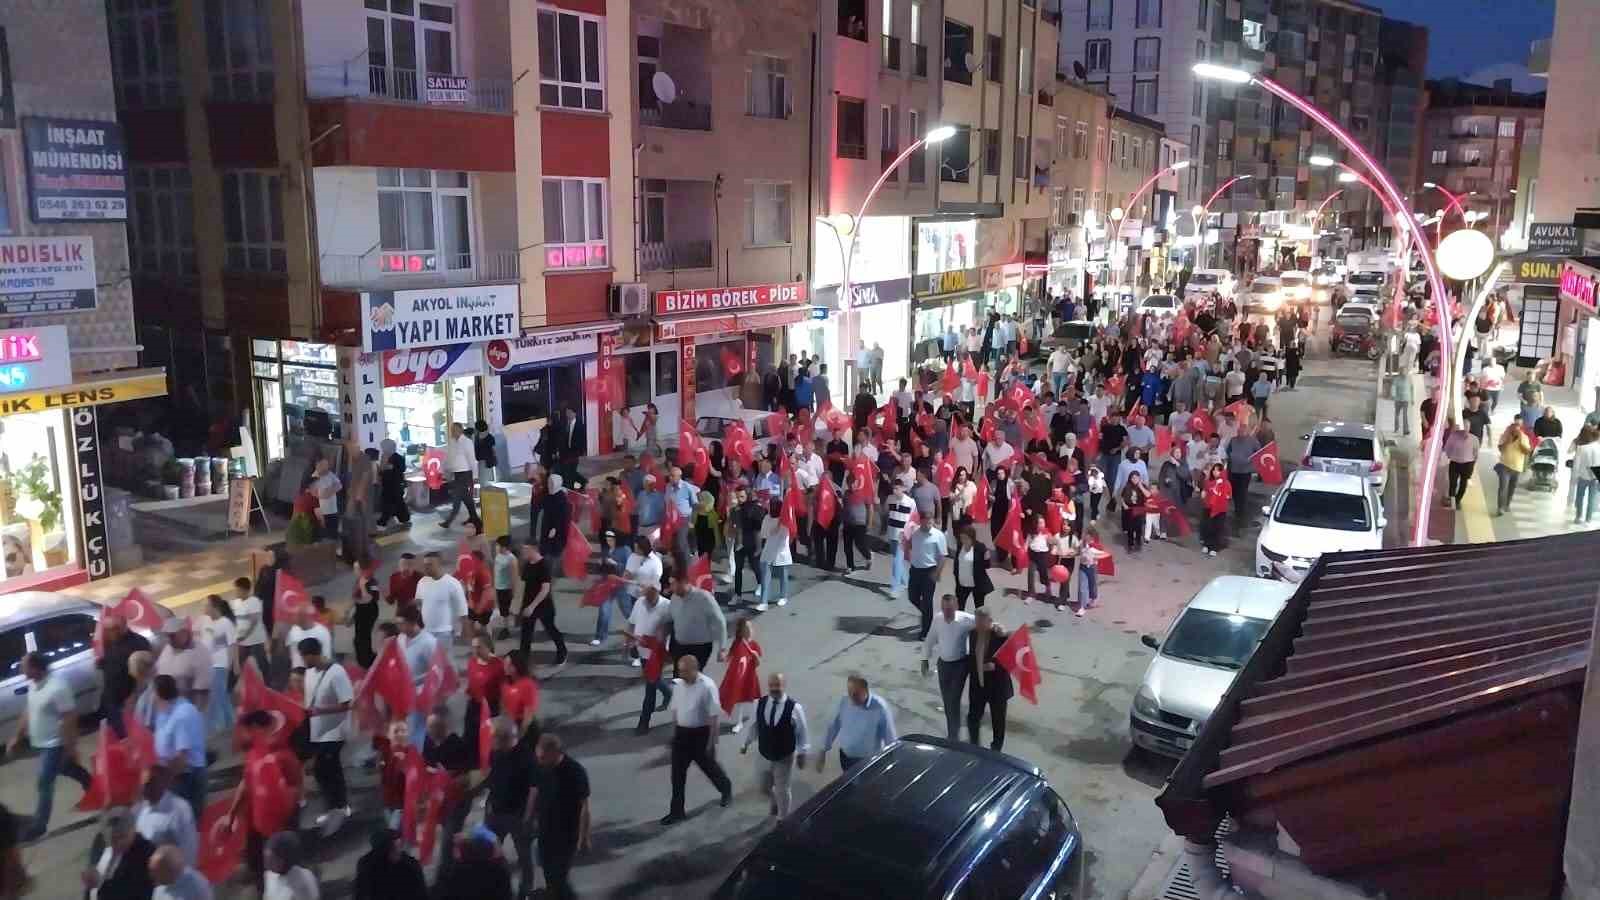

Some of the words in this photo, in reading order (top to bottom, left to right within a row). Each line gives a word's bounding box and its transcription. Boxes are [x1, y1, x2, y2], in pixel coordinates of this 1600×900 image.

[427, 77, 467, 89] SATILIK
[1535, 226, 1577, 238] AVUKAT
[412, 297, 453, 312] AKYOL
[665, 292, 708, 311] BİZİM
[711, 289, 759, 309] BÖREK
[769, 284, 799, 303] PİDE
[397, 318, 440, 344] YAPI
[445, 312, 515, 340] MARKET
[44, 386, 116, 408] LENS
[74, 407, 106, 578] ÖZLÜKÇÜ
